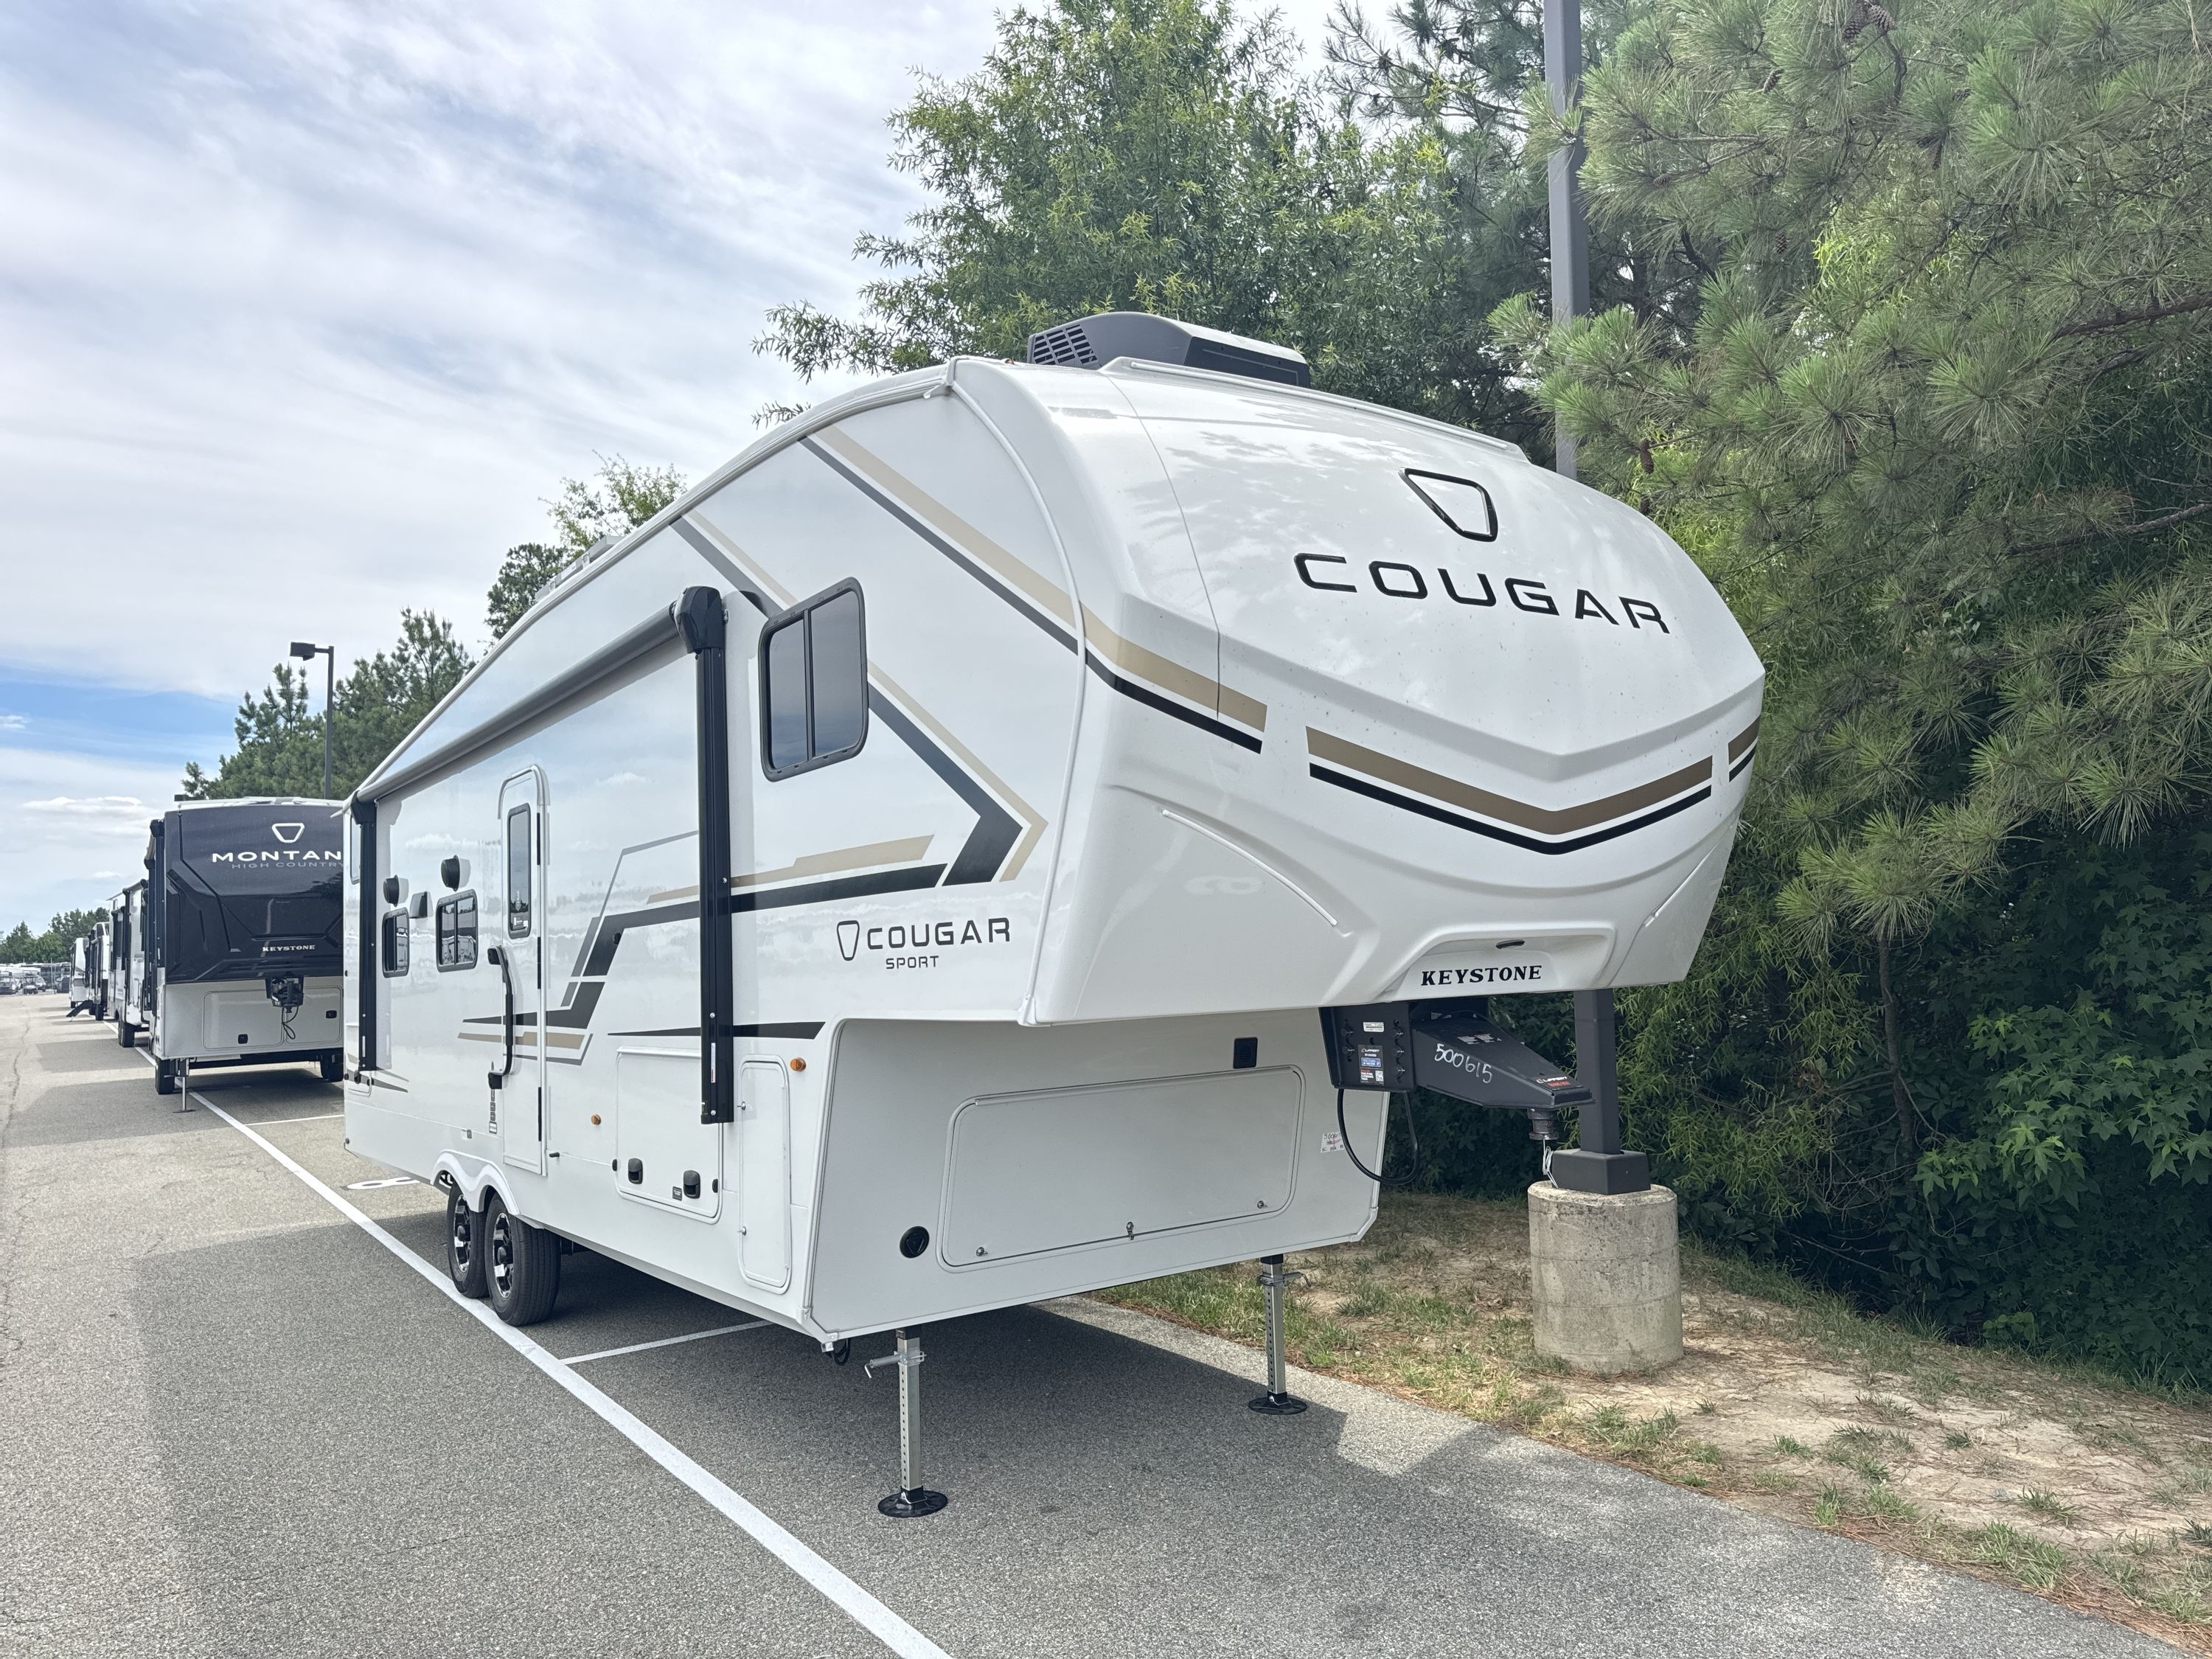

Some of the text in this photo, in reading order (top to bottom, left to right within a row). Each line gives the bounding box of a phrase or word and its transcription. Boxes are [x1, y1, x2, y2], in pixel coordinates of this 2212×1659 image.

[1293, 552, 1670, 634] COUGAR
[212, 850, 341, 863] MONTAN
[866, 917, 1010, 950] COUGAR
[886, 956, 939, 970] SPORT
[1421, 964, 1543, 986] KEYSTONE
[1434, 1043, 1492, 1084] 500615
